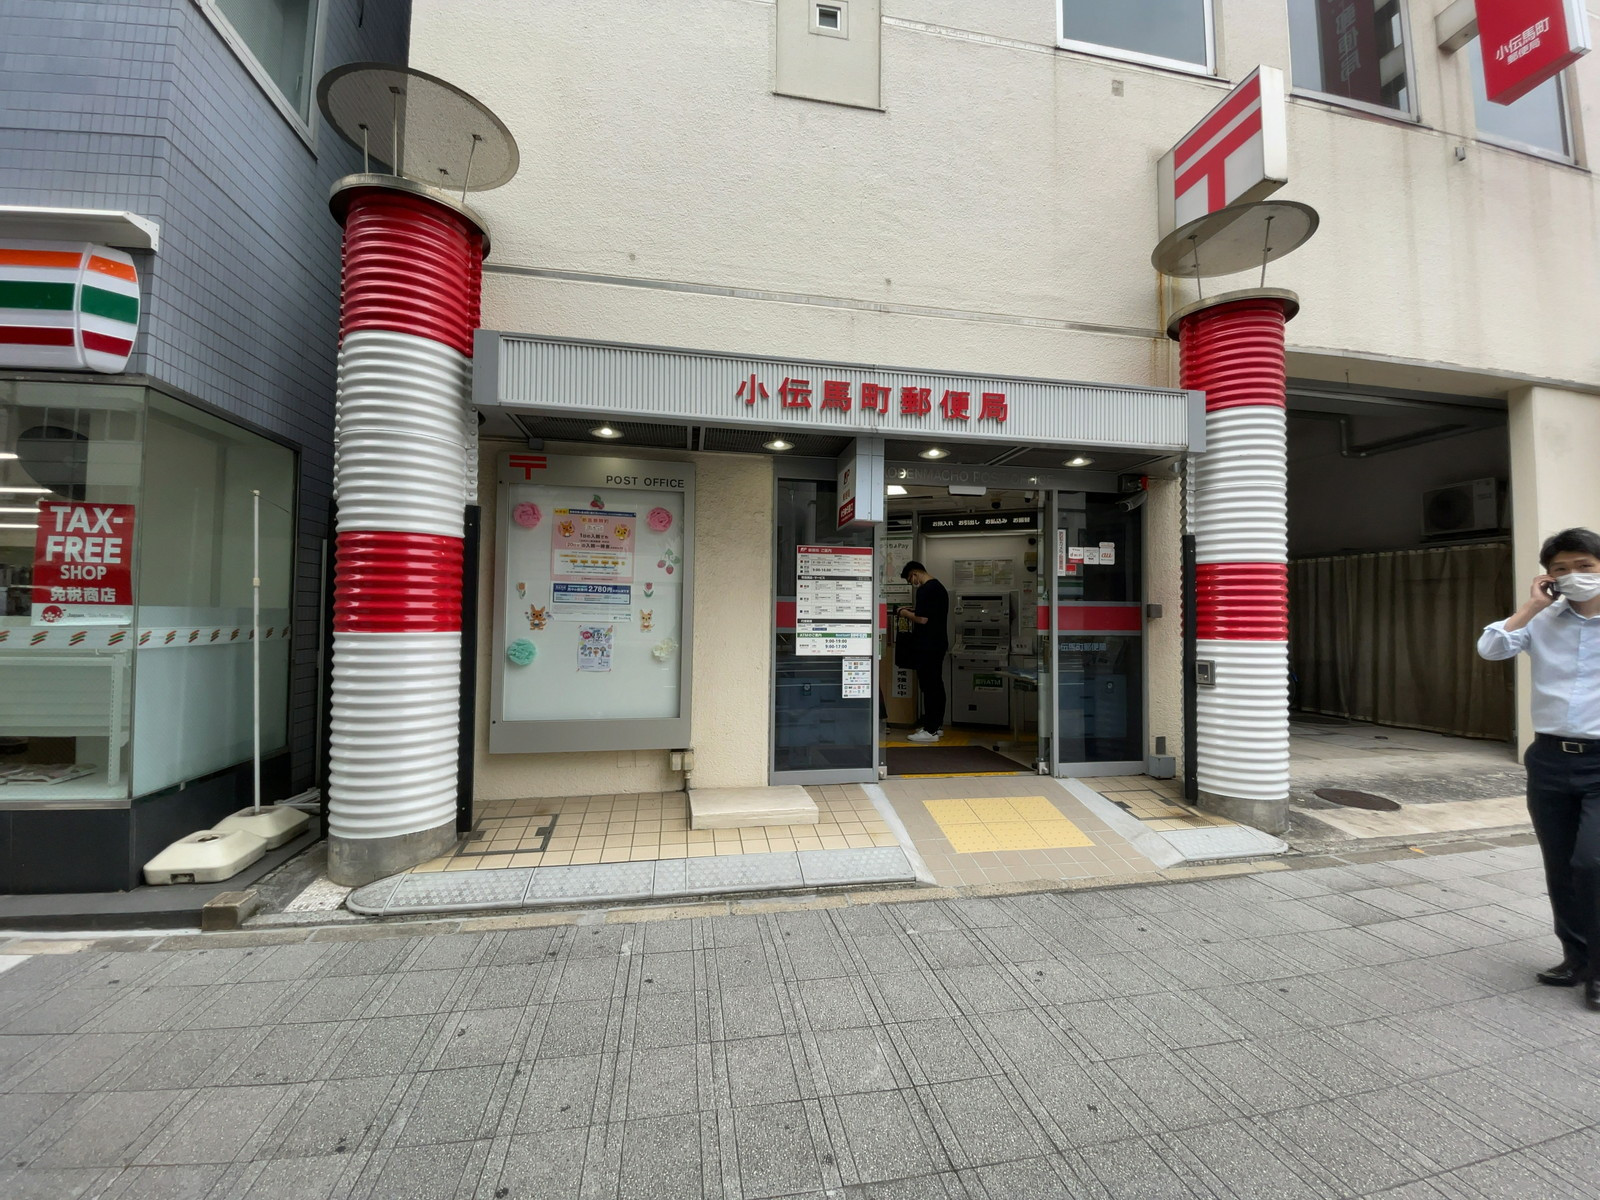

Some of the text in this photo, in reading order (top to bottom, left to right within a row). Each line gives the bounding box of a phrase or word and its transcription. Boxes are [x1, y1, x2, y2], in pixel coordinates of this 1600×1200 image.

[1495, 17, 1550, 61] 小伝馬町
[1507, 37, 1541, 65] 郵便局
[735, 373, 1009, 424] 小伝馬町郵便局
[605, 475, 685, 489] POST OFFICE
[50, 505, 124, 534] TAX-
[45, 535, 123, 564] FREE
[60, 564, 107, 580] SHOP
[50, 586, 116, 602] 免税商店
[1058, 642, 1107, 652] 伝馬町郵便局
